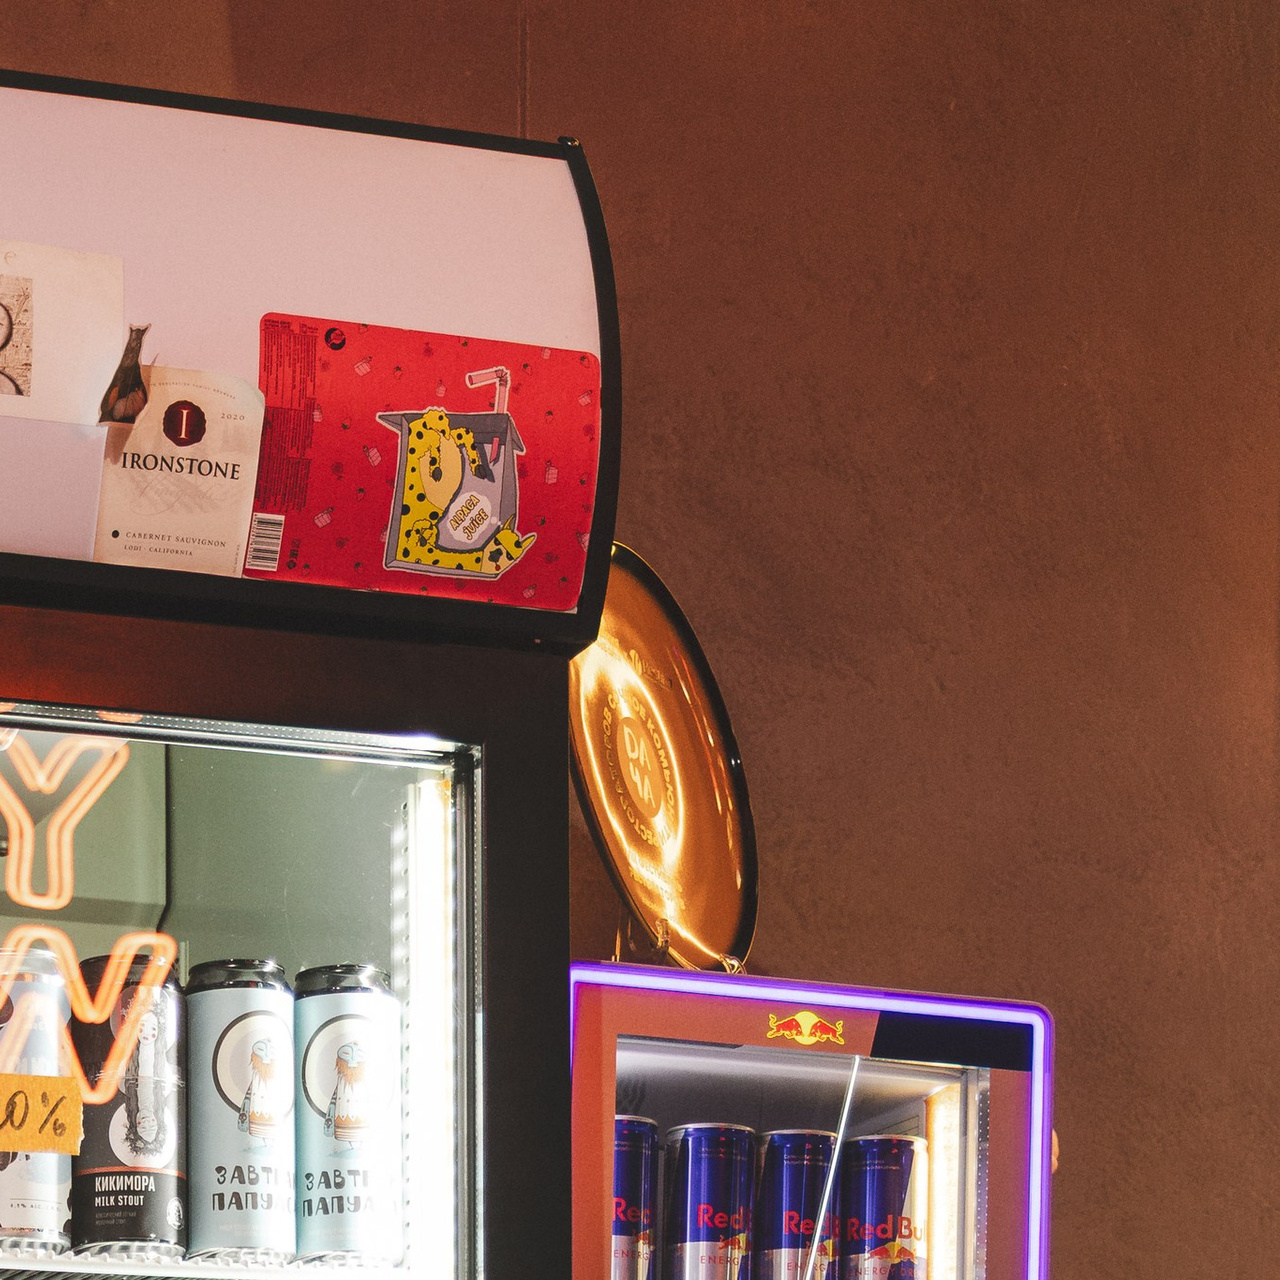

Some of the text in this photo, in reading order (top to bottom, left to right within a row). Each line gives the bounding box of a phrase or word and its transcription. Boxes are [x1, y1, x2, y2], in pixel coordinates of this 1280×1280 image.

[221, 412, 246, 421] 2020
[121, 452, 241, 480] IRONSTONE
[125, 531, 227, 548] CABERNET SAUVIGNON
[149, 547, 193, 556] CALIFORNIA
[95, 1175, 156, 1193] КИКИМОРА
[95, 1195, 145, 1207] MILK STOUT
[847, 1217, 893, 1241] Red
